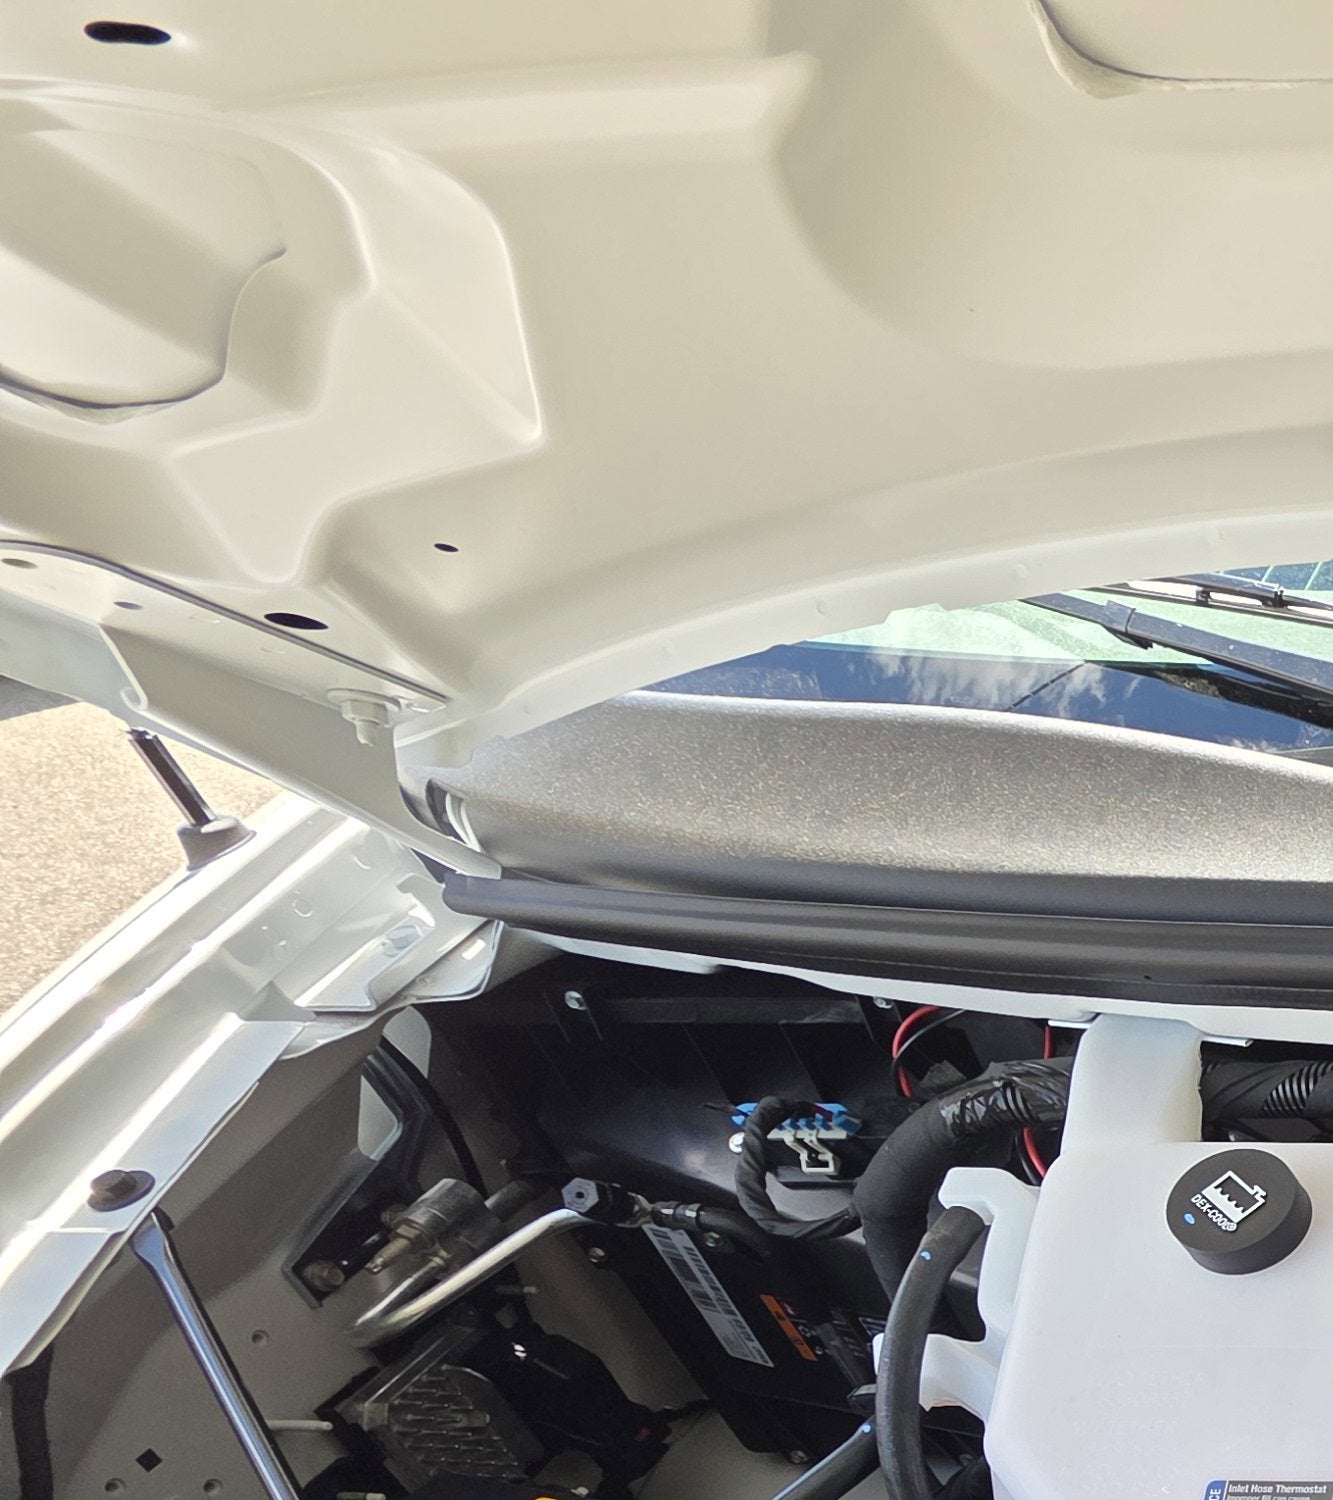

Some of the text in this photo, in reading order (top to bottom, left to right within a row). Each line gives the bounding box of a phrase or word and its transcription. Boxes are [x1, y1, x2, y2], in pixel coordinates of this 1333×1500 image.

[1228, 1484, 1328, 1494] Inlet Hose Thermostat
